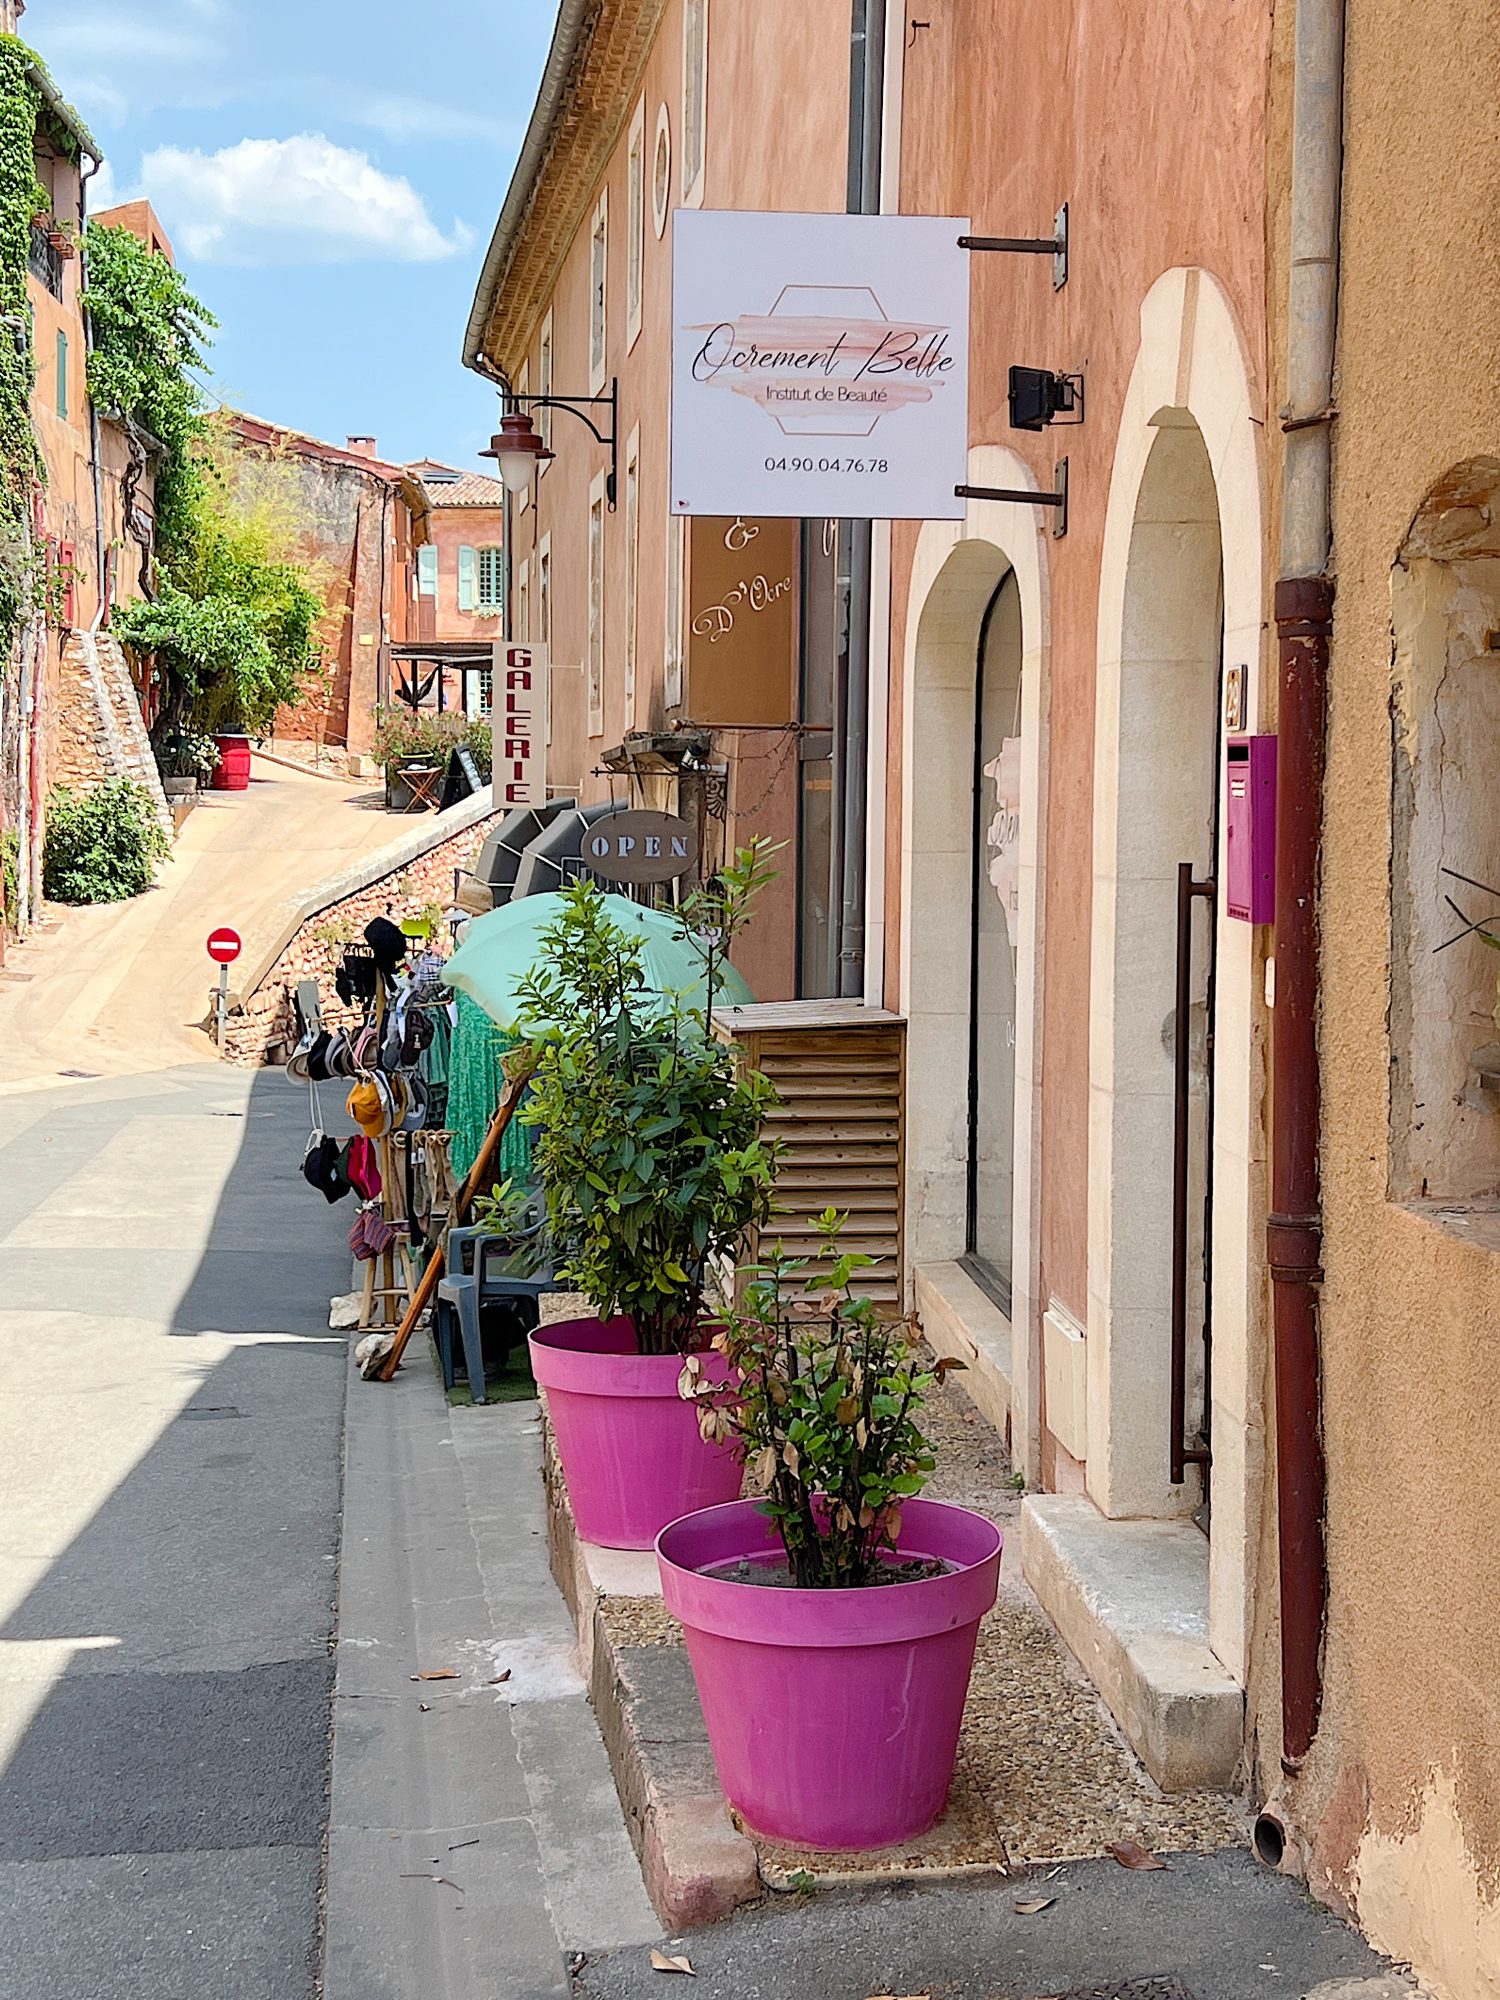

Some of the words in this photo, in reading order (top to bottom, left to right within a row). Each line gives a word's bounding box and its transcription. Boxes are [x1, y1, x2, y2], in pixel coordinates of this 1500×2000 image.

[692, 322, 847, 382] Ocrement
[853, 330, 956, 382] Belle
[766, 385, 812, 402] Institut
[814, 386, 834, 402] de
[838, 386, 888, 403] Beauté
[764, 456, 889, 474] 04.90.04.76.78
[505, 648, 532, 804] GALERIE
[591, 836, 688, 857] OPEN
